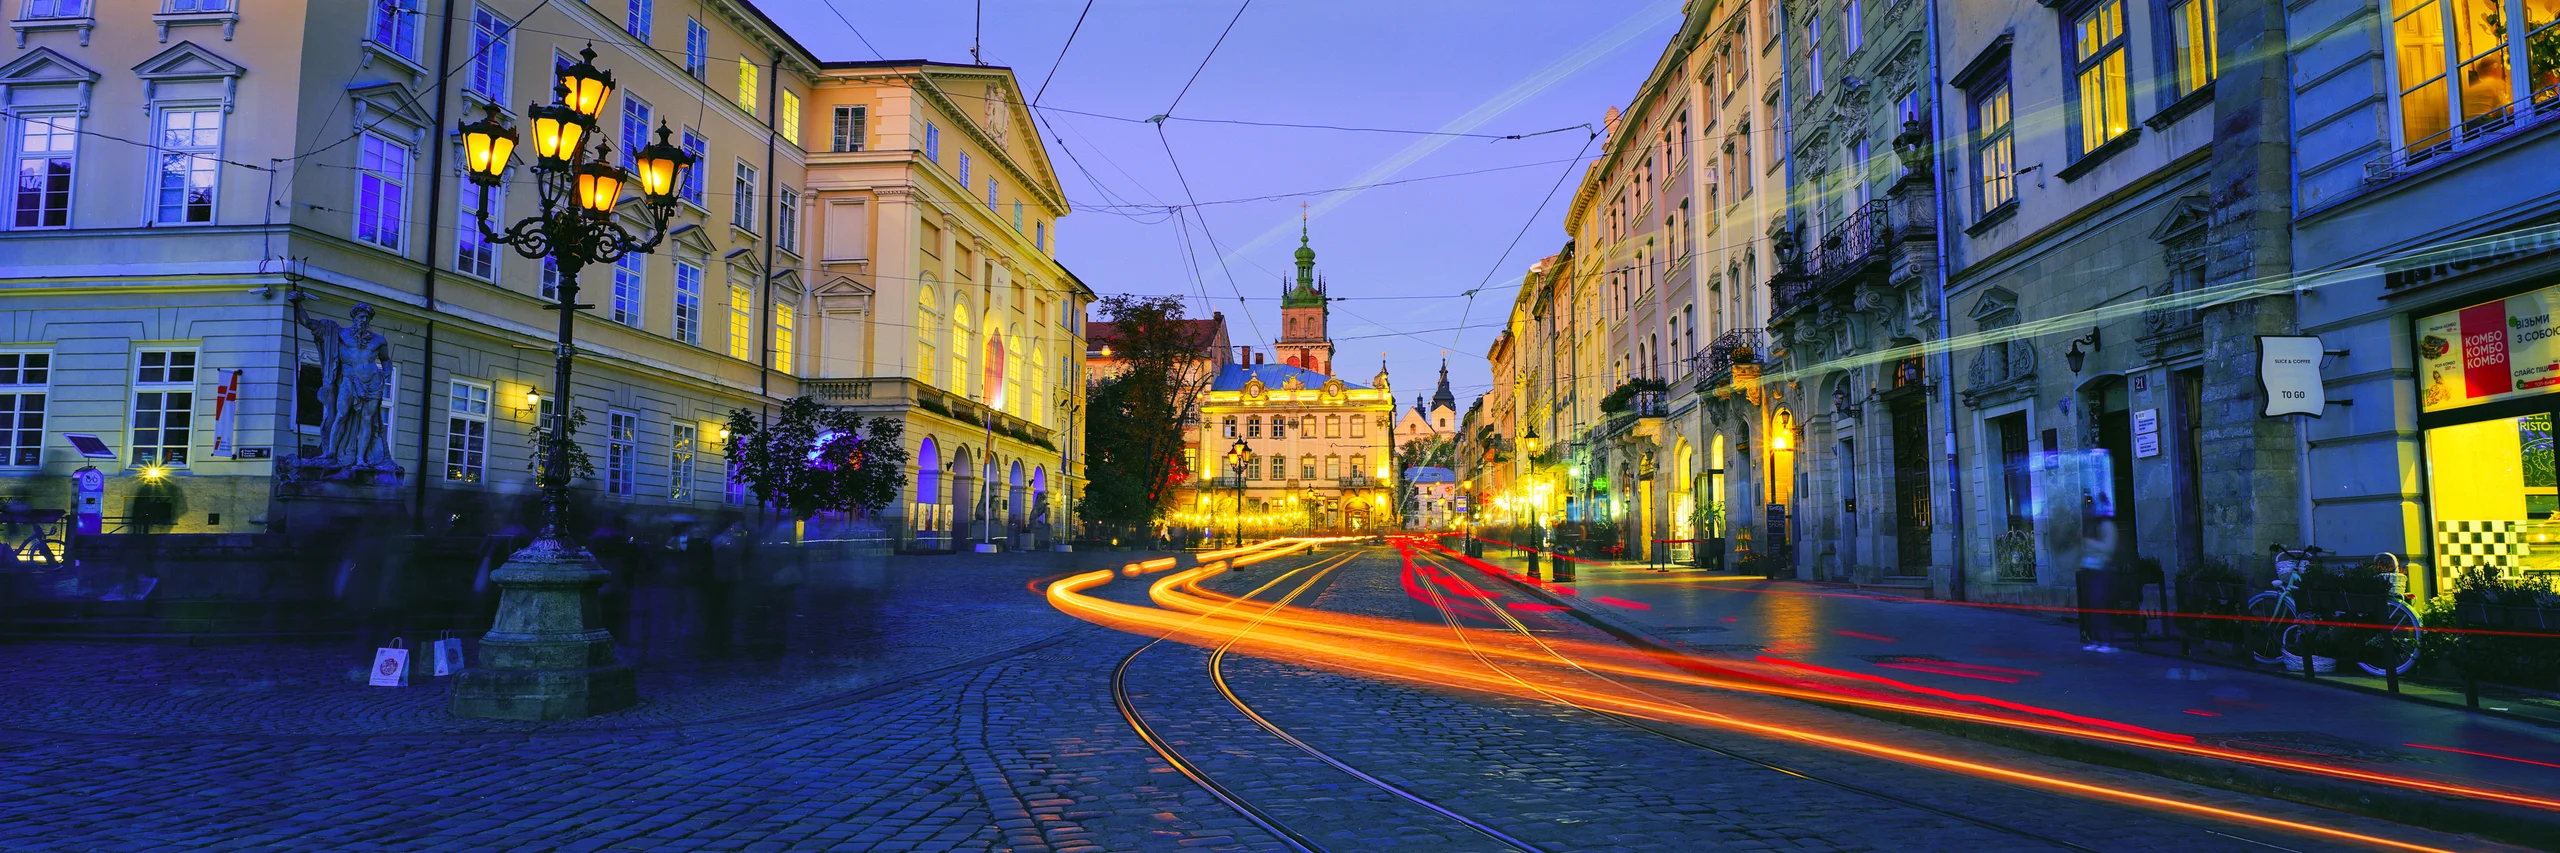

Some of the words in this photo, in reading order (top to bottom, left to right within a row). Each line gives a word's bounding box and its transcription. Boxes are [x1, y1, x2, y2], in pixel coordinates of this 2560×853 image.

[2516, 314, 2550, 330] ВІЗЬМИ
[2465, 330, 2502, 347] КОМБО
[2466, 341, 2504, 358] КОМБО
[2467, 353, 2504, 369] КОМБО
[2514, 367, 2535, 377] СЛАЙС
[2136, 378, 2144, 389] 21
[2281, 390, 2292, 398] TO
[2294, 390, 2305, 398] GO
[2520, 421, 2553, 432] RISTO
